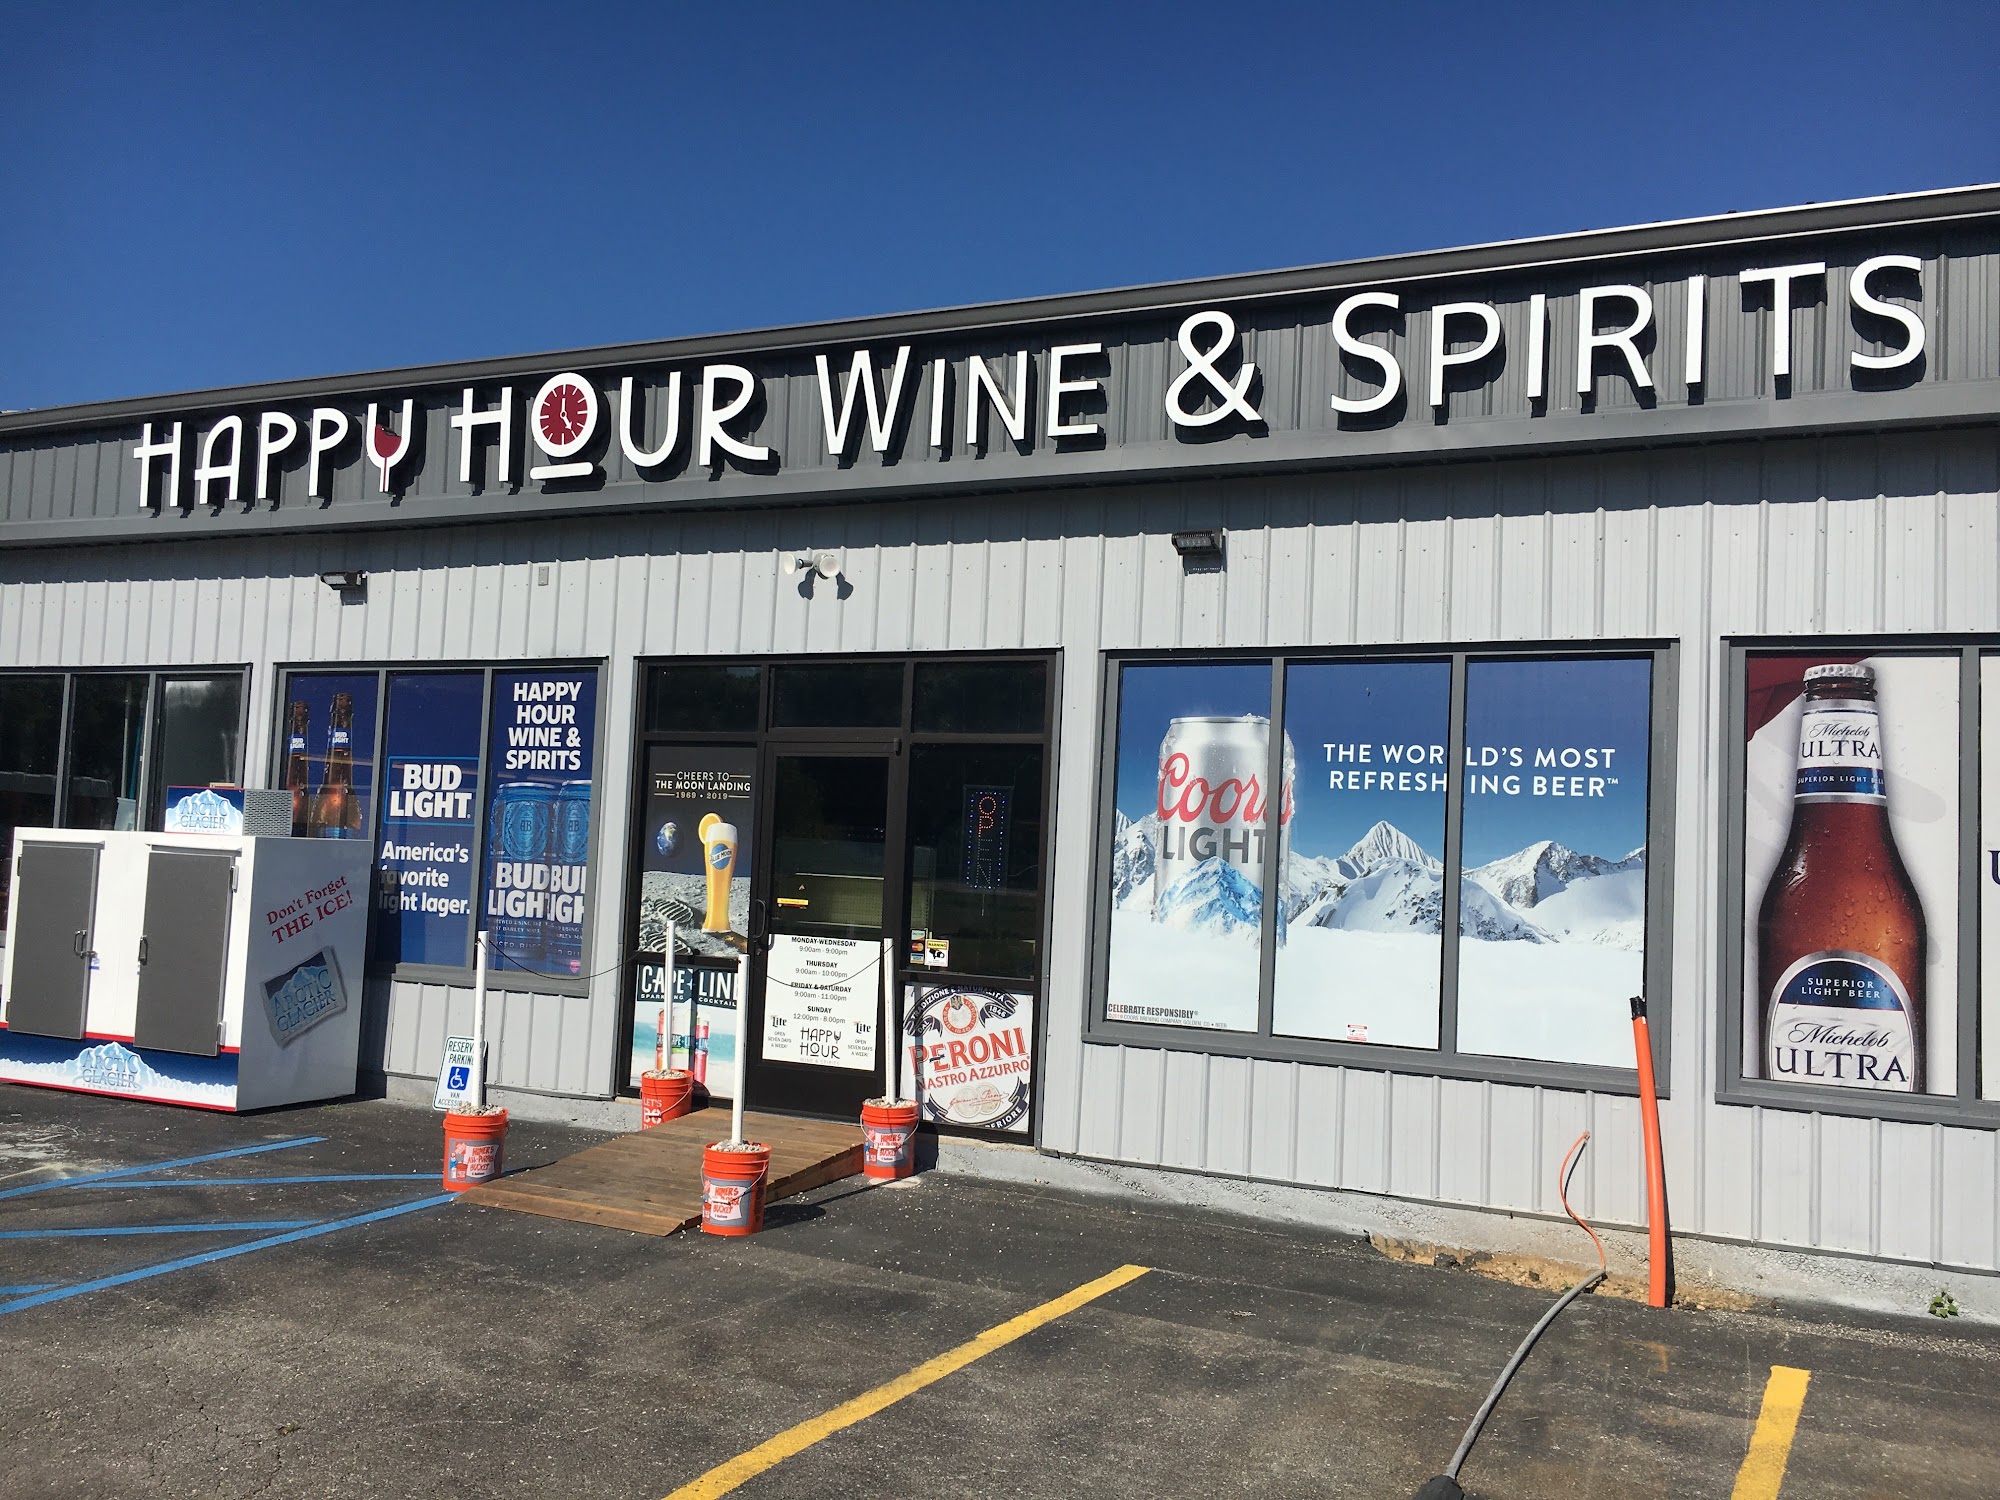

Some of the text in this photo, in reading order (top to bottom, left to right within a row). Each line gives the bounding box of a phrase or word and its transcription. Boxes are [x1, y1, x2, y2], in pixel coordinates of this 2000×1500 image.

[134, 255, 1926, 507] HAPPY HOUR WINE & SPIRITS
[513, 682, 582, 701] HAPPY
[517, 705, 575, 724] HOUR
[508, 727, 581, 748] WINE &
[1809, 723, 1870, 738] Michelob
[1323, 743, 1615, 769] THE WORLD'S MOST
[1801, 739, 1880, 759] ULTRA
[505, 750, 581, 771] SPIRITS
[403, 764, 462, 791] BUD
[655, 780, 751, 791] THE MOON LANDING
[677, 771, 730, 781] CHEERS TO
[1329, 771, 1520, 795] REFRESHING
[1798, 775, 1835, 784] SUPERIOR
[1839, 775, 1867, 783] LIGHT
[390, 791, 473, 818] LIGHT
[676, 791, 728, 800] 1969 2019
[180, 800, 228, 816] ARCTIC
[180, 815, 226, 829] GLACIER
[381, 841, 469, 863] America's
[496, 862, 550, 890] BUD
[266, 875, 348, 925] Don't Forget
[421, 892, 470, 918] lager.
[272, 889, 353, 944] THE ICE!
[806, 960, 838, 968] THURSDAY
[641, 965, 685, 994] CAE
[1807, 977, 1874, 989] SUPERIOR
[273, 969, 332, 1017] ARCTIC
[1801, 986, 1881, 998] LIGHT BEER
[276, 989, 336, 1031] GLACIER
[807, 1006, 832, 1014] SUNDAY
[1108, 1003, 1145, 1015] CELEBRATE
[772, 1016, 787, 1027] Lite
[856, 1022, 871, 1034] Lite
[917, 1020, 930, 1033] DAL
[800, 1027, 841, 1044] HAPPY
[1788, 1022, 1890, 1048] Michelob
[448, 1040, 474, 1053] RESERV
[800, 1042, 840, 1059] HOUR
[908, 1027, 1028, 1075] PERONI
[82, 1049, 139, 1074] ARCTIC
[449, 1053, 474, 1065] PARKIN
[1775, 1047, 1907, 1082] ULTRA
[82, 1068, 137, 1089] GLACIER
[916, 1059, 1029, 1091] NASTRO AZZURRO
[643, 1097, 662, 1107] LET'S
